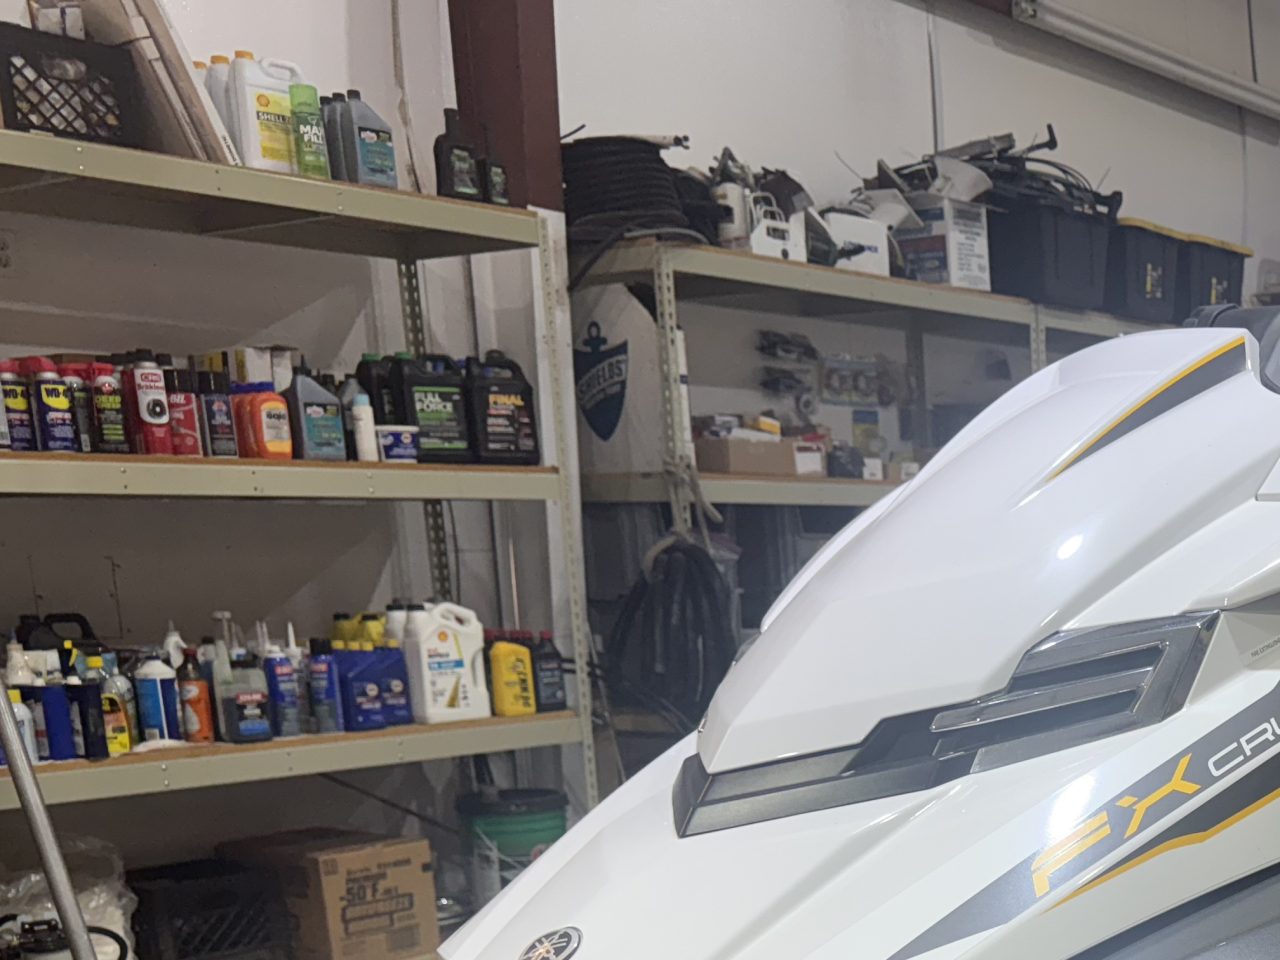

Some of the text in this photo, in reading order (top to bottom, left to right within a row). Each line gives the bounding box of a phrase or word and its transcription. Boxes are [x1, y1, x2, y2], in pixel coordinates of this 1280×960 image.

[414, 392, 441, 404] FULL
[489, 394, 525, 406] FINAL
[1033, 753, 1202, 898] FX
